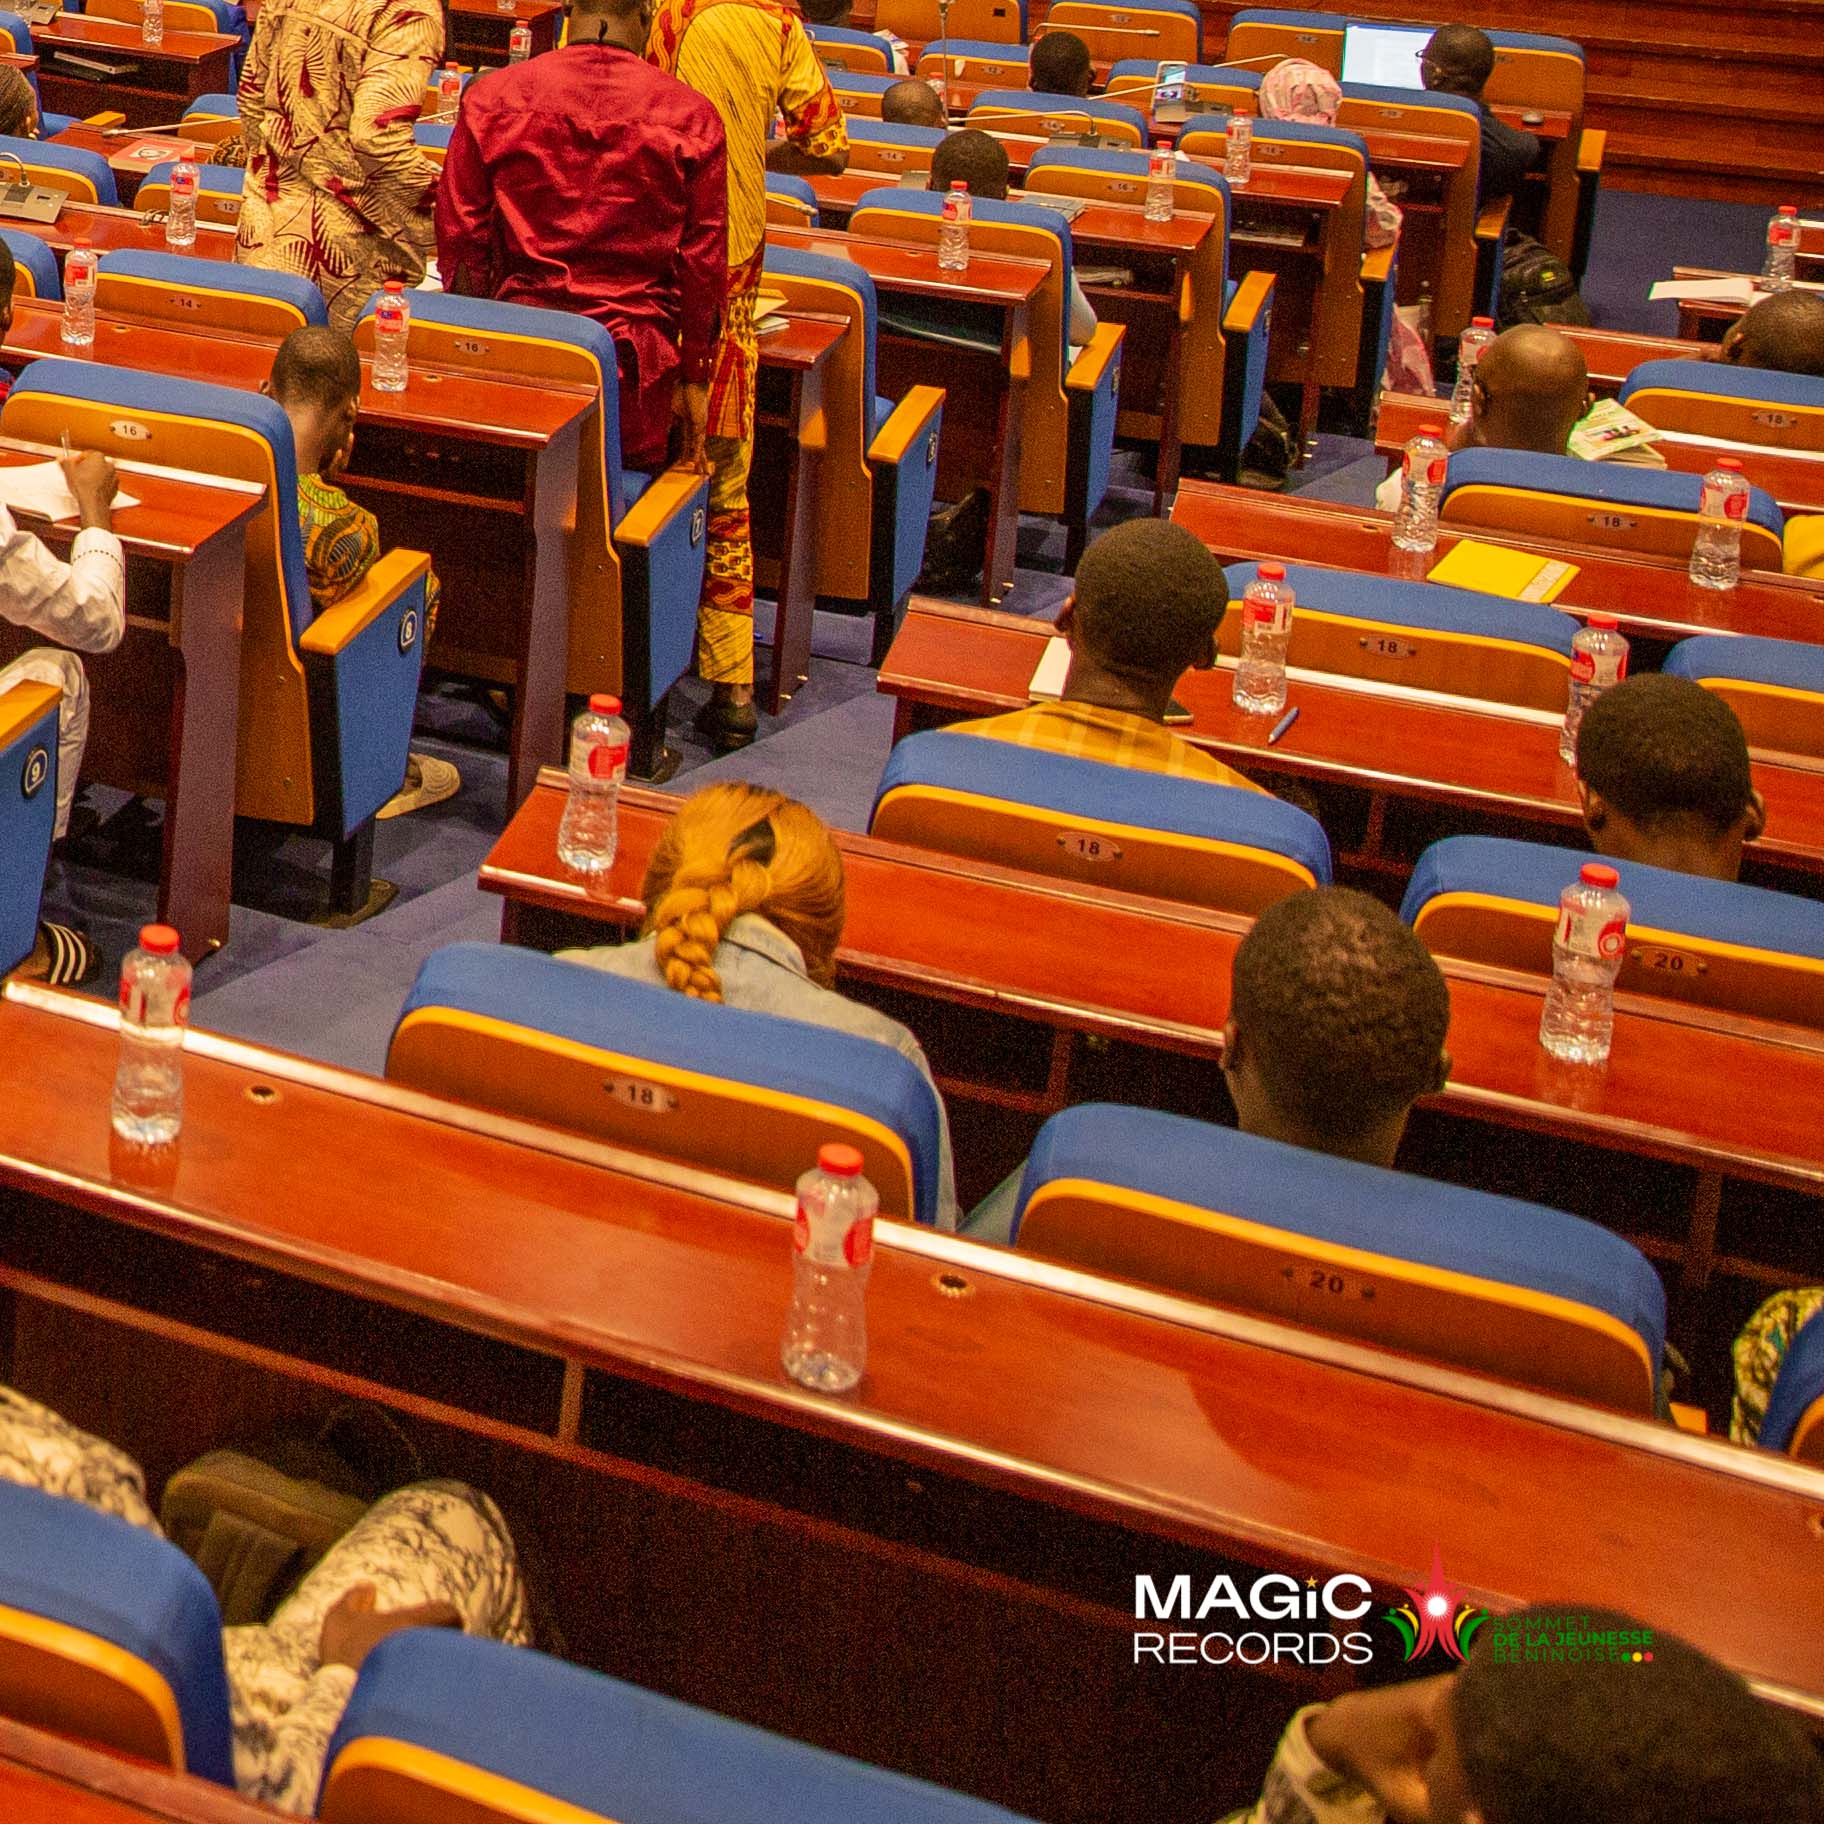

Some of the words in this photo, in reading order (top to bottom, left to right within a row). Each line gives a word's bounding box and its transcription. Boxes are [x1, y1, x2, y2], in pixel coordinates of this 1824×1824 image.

[223, 203, 234, 212] 12
[180, 299, 192, 309] 14
[465, 342, 478, 352] 16
[1768, 414, 1783, 425] 18
[123, 424, 137, 435] 16
[1604, 516, 1620, 527] 18
[1378, 639, 1398, 654] 18
[32, 765, 40, 782] 9
[1078, 839, 1100, 856] 18
[1653, 952, 1684, 971] 20
[628, 1085, 654, 1104] 18
[1309, 1270, 1345, 1293] 20
